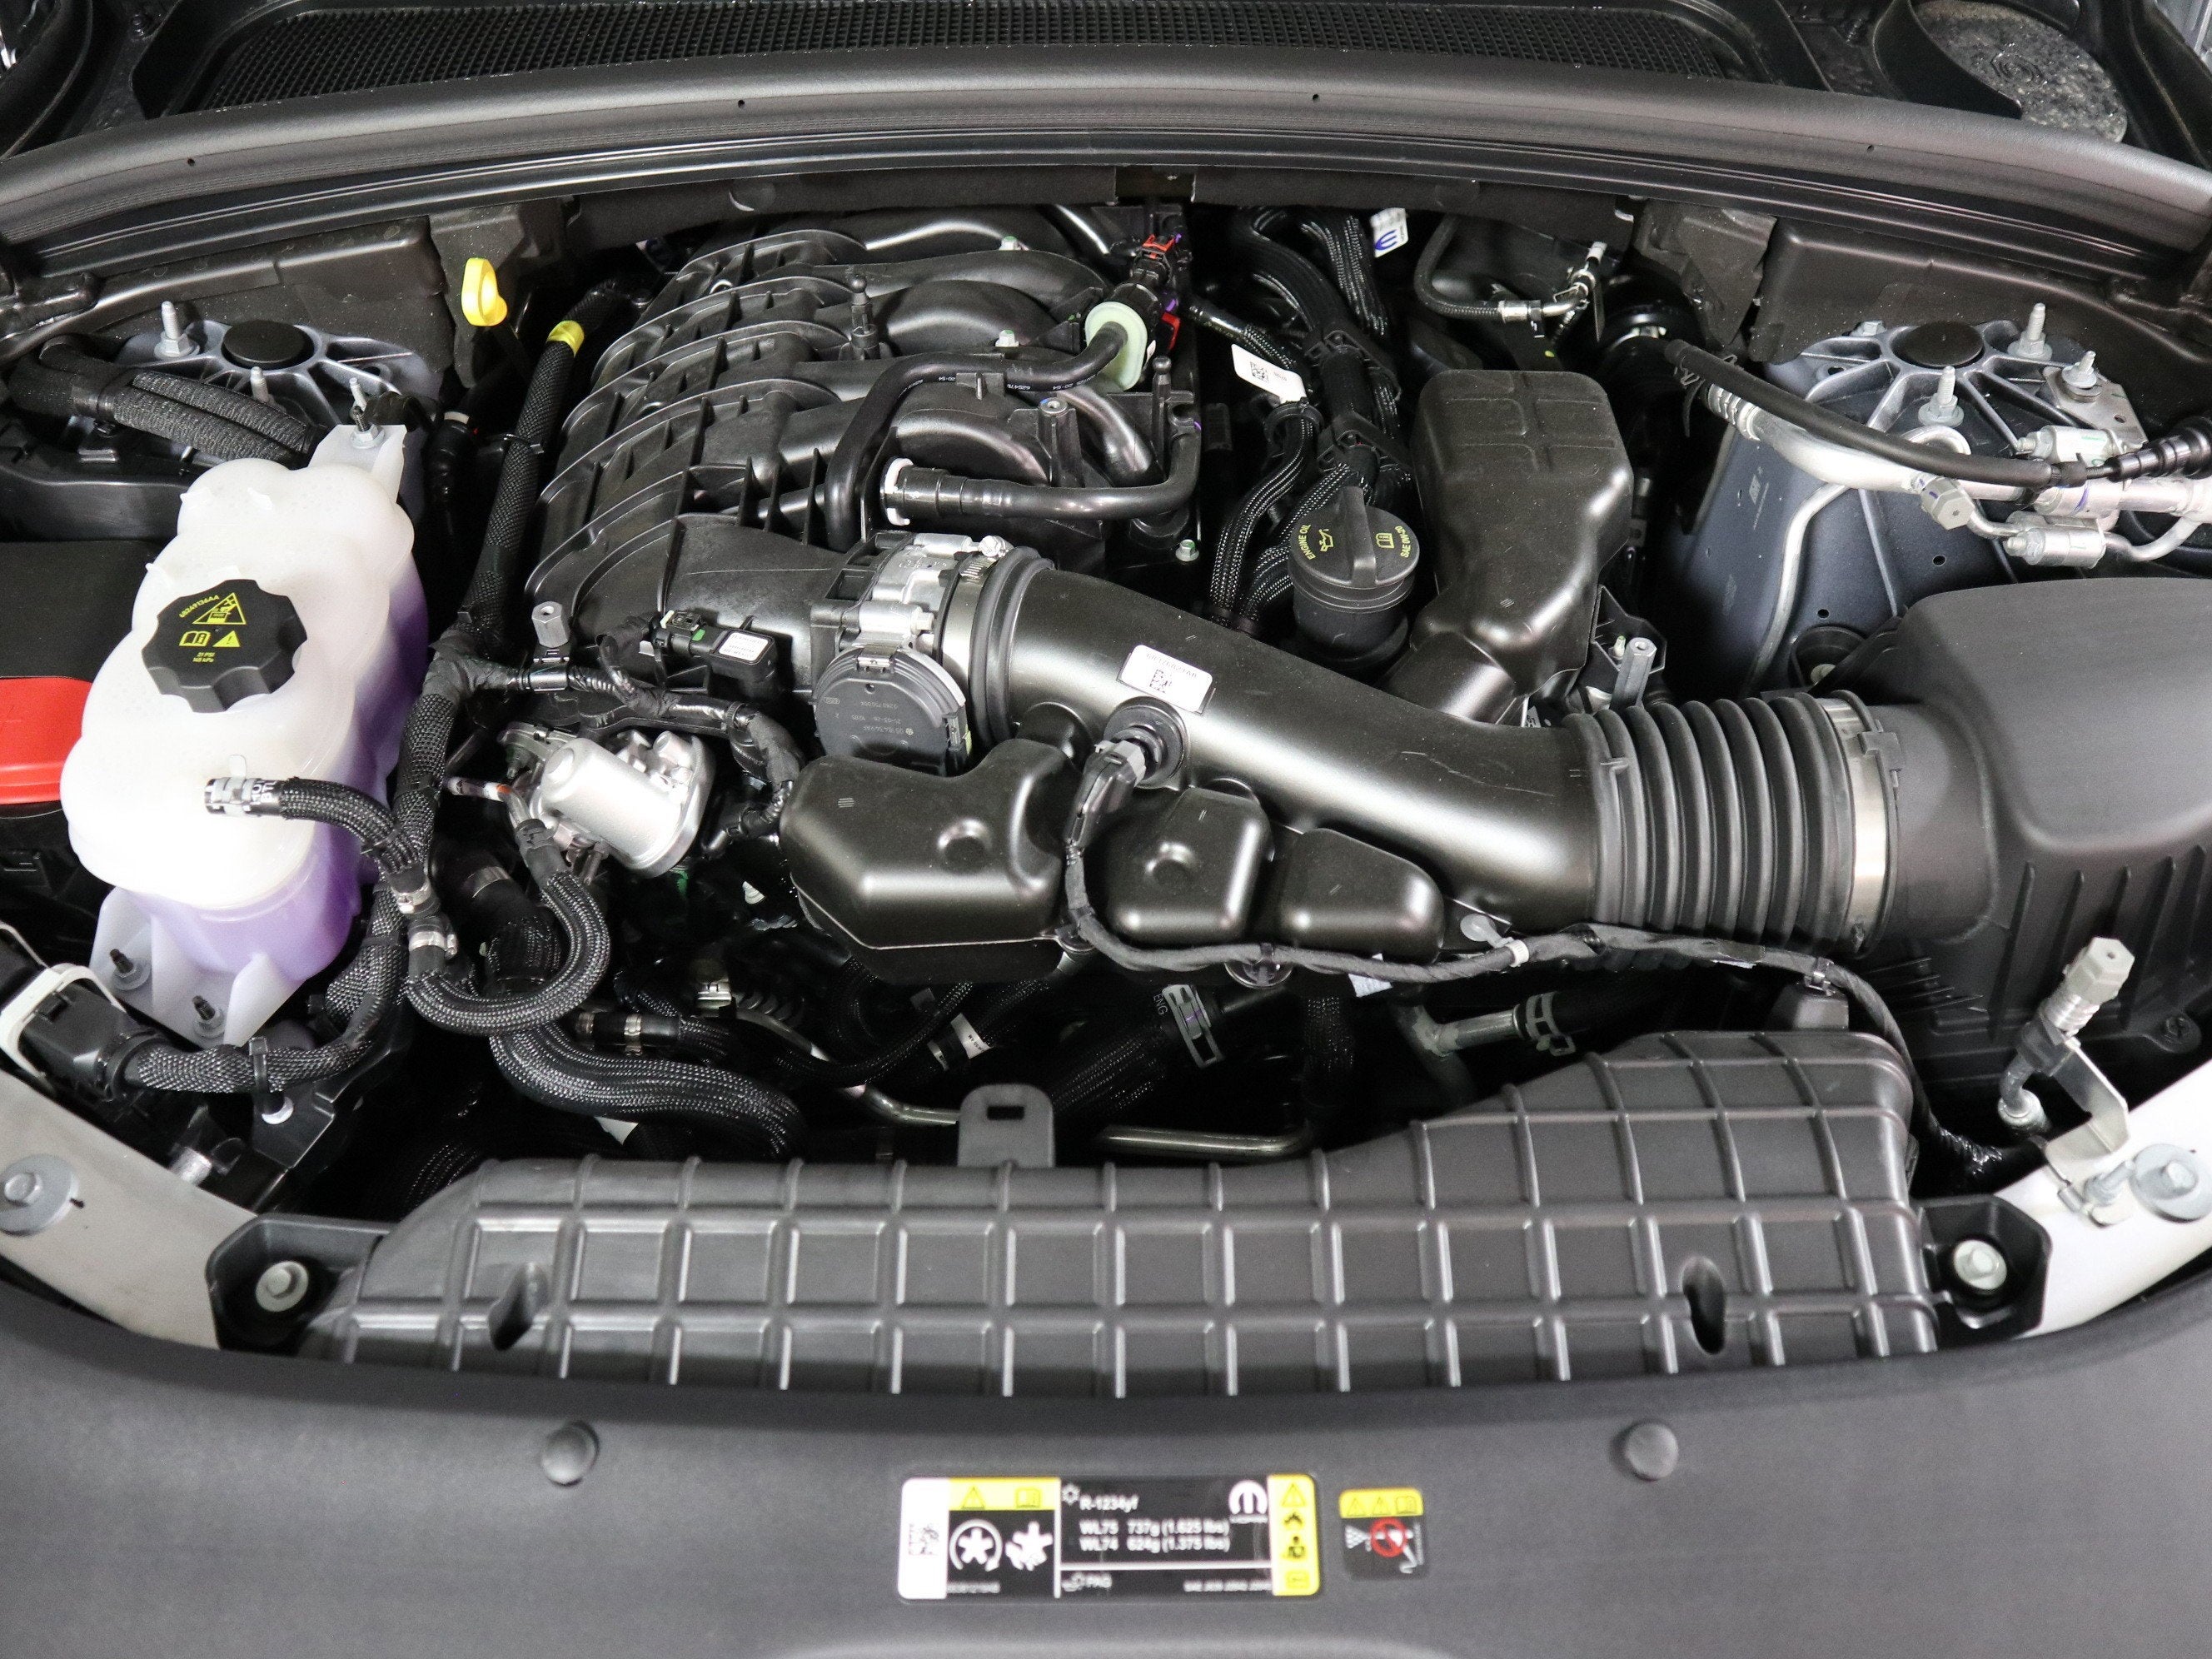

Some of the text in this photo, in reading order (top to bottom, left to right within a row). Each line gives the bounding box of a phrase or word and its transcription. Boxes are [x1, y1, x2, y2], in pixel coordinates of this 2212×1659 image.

[1298, 524, 1317, 560] ENGINE OIL
[1394, 526, 1411, 558] SAE 0W-20
[1153, 994, 1168, 1015] ENG
[1079, 1494, 1139, 1513] R-1234yf
[1079, 1518, 1118, 1535] WL75
[1127, 1518, 1160, 1537] 737g
[1203, 1517, 1230, 1537] lbs)
[1079, 1534, 1230, 1554] WL74 624g (1.375 lbs)
